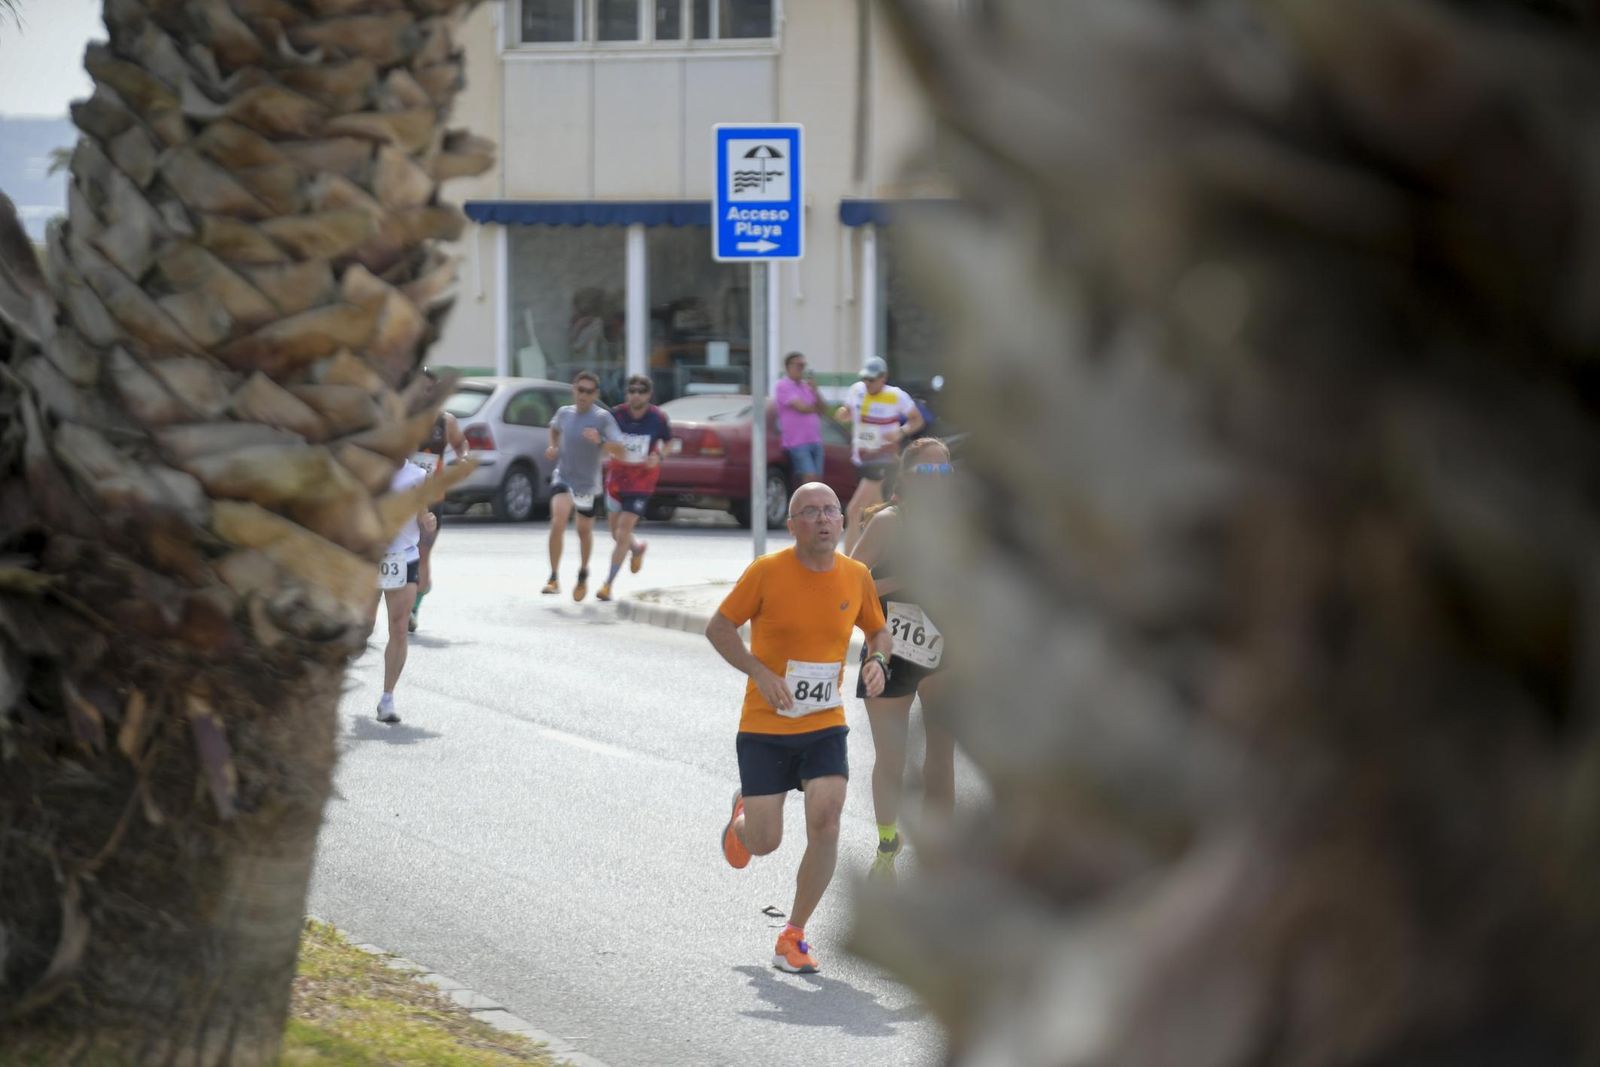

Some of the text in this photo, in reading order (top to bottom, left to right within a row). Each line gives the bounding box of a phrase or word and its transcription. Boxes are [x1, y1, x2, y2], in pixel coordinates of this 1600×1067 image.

[727, 206, 789, 221] Acceso
[735, 222, 782, 239] Playa
[795, 680, 832, 702] 840
